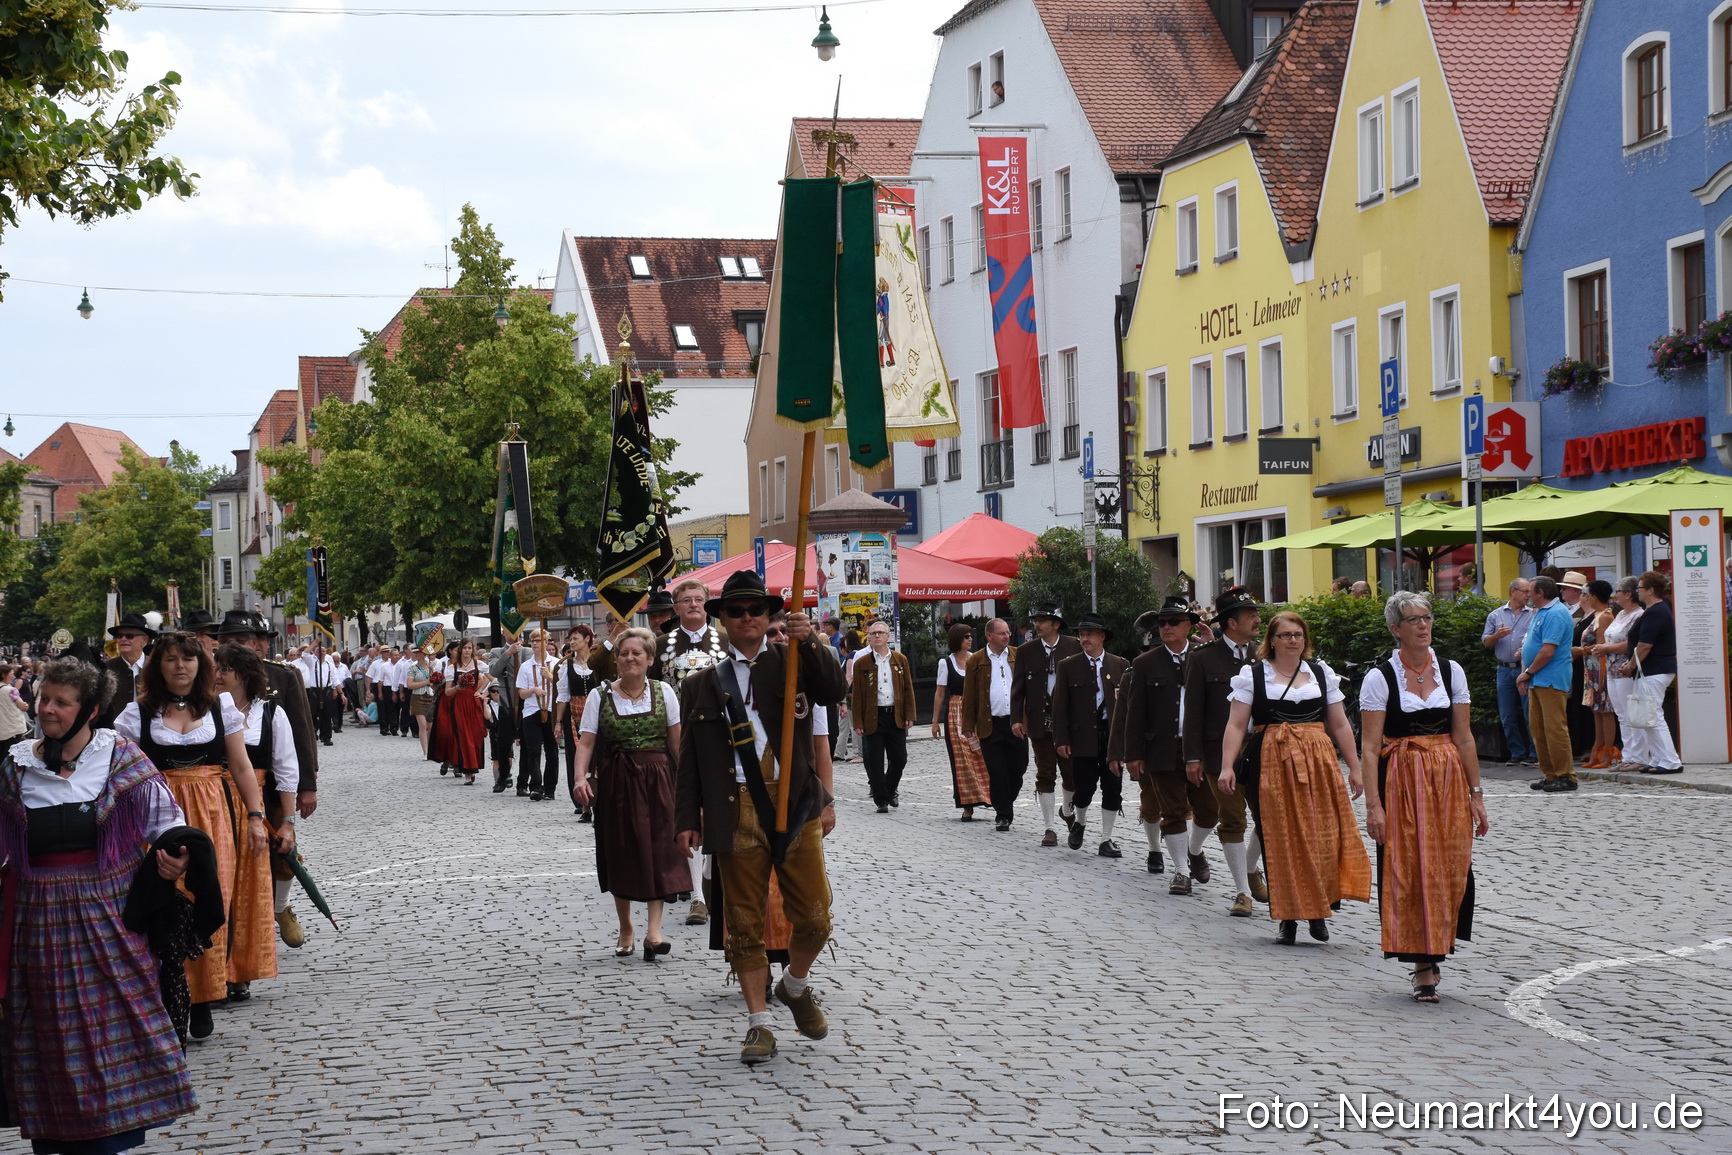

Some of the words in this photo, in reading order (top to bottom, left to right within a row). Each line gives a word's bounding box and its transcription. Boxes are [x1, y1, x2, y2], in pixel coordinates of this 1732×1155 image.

[987, 147, 1011, 215] K&L
[1011, 147, 1020, 215] RUPPERT
[1200, 303, 1242, 344] HOTEL
[1252, 290, 1302, 327] Lehmeier
[1384, 368, 1394, 409] P
[1468, 403, 1479, 447] P
[1085, 443, 1092, 473] P
[1364, 433, 1410, 461] TAIN
[1560, 416, 1706, 478] APOTHEKE
[1263, 461, 1309, 469] TAIFUN
[1200, 480, 1259, 508] Restaurant
[756, 543, 763, 569] P
[905, 588, 925, 596] Hotel
[927, 587, 967, 596] Restaurant
[969, 588, 1004, 596] Lehmeier
